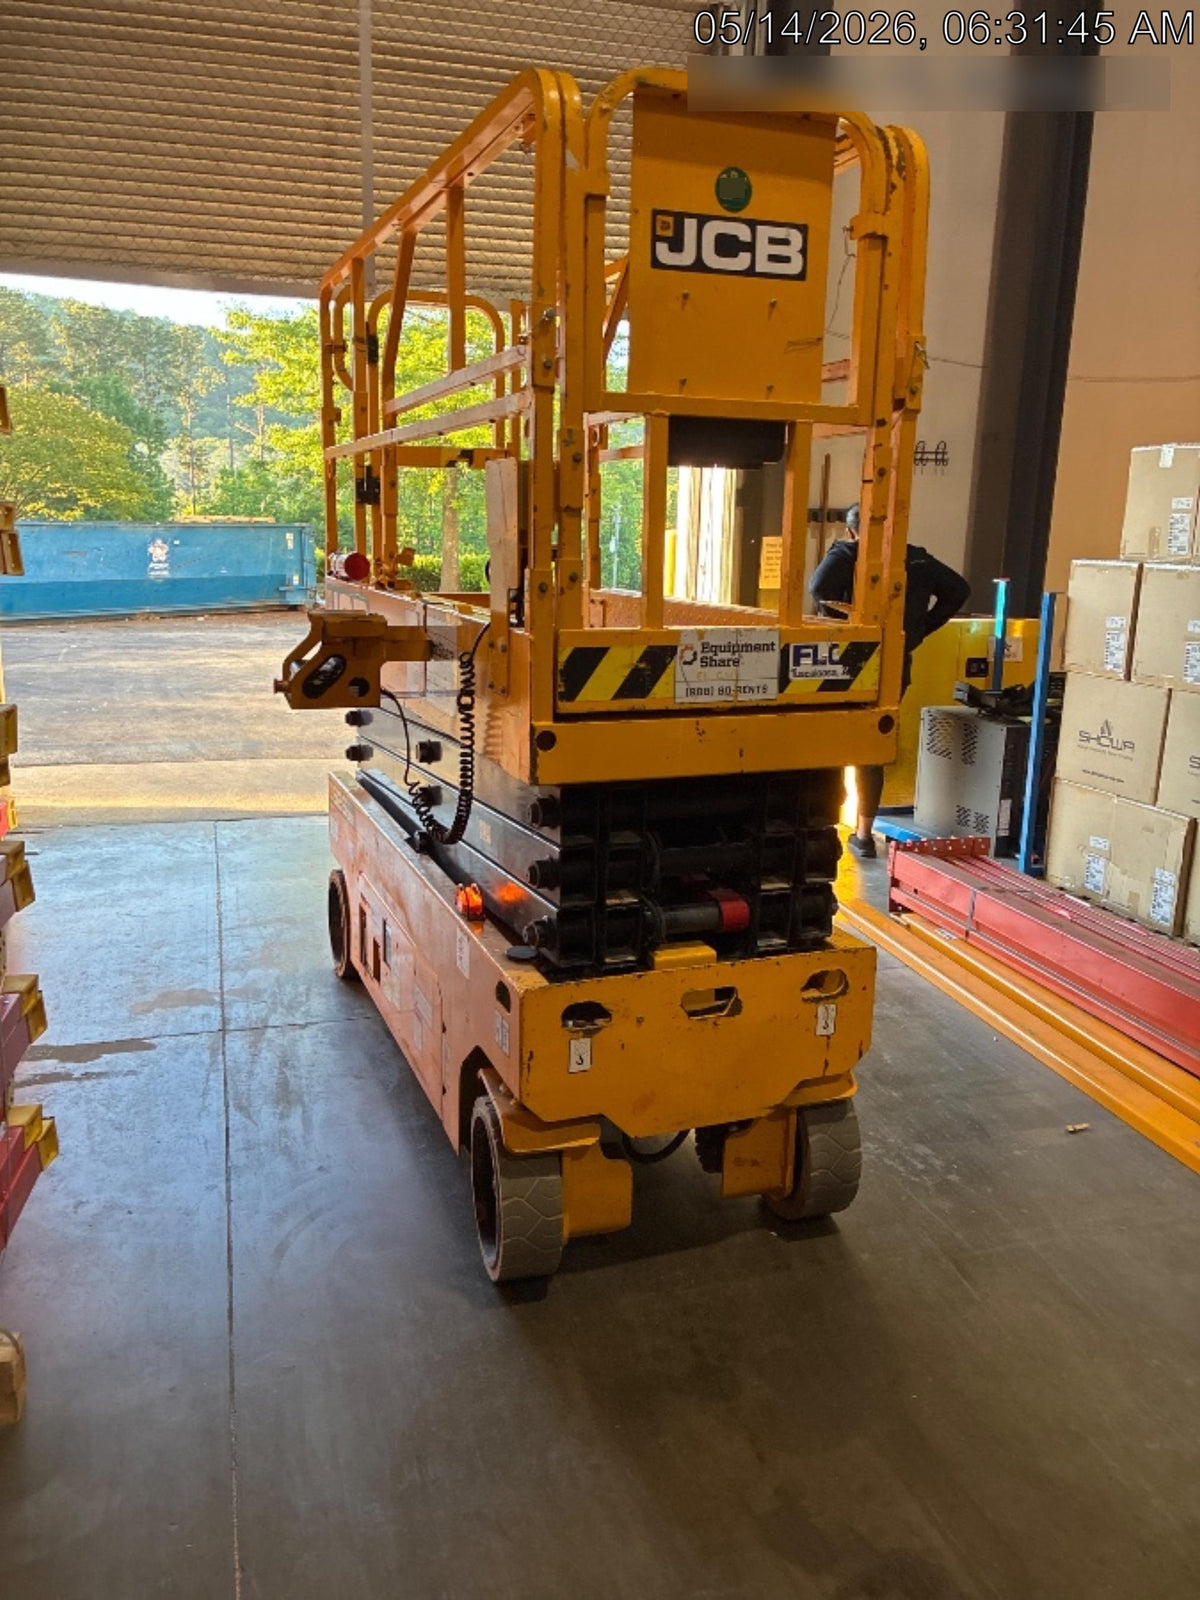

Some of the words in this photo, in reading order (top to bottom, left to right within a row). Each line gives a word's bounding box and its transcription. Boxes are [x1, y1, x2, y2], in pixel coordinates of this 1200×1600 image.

[655, 217, 803, 275] JCB
[701, 641, 776, 657] Equipment
[700, 655, 741, 668] Share
